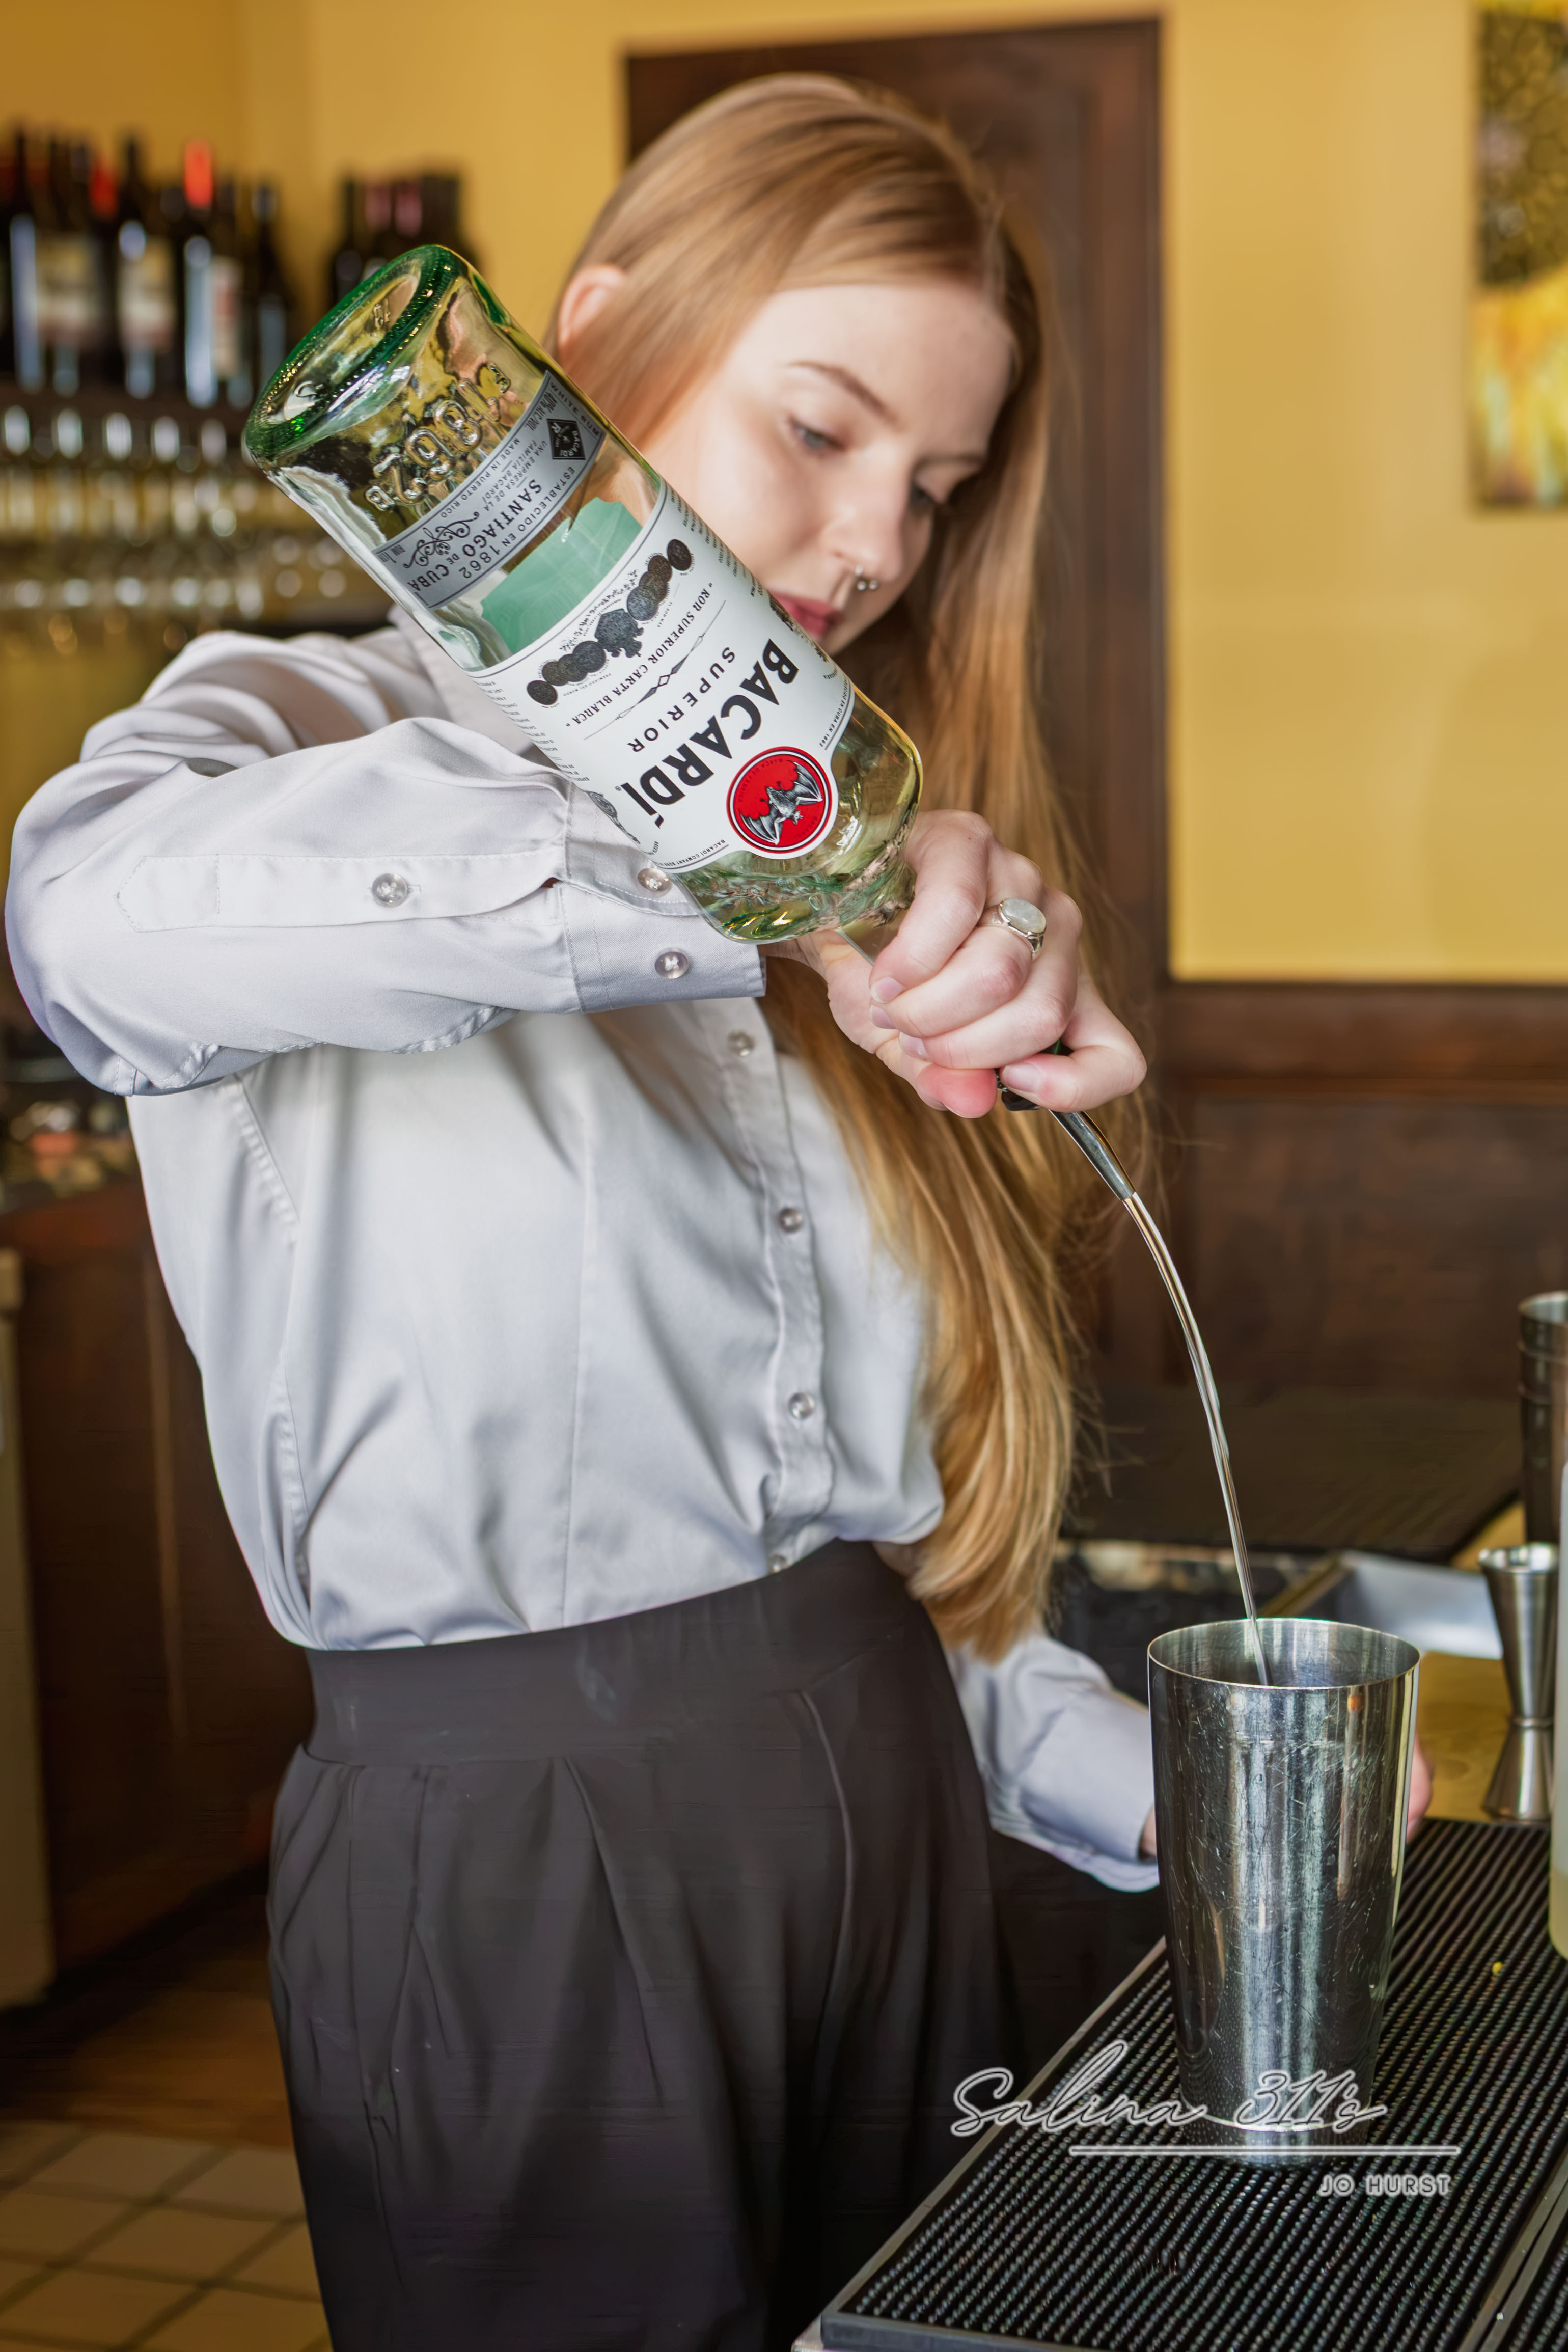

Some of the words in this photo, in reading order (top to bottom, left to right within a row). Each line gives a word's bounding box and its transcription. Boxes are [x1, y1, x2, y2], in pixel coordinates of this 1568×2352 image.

[500, 437, 519, 460] MADE
[511, 440, 536, 469] FAMILIA
[534, 440, 546, 455] UNA
[490, 460, 500, 470] IN
[505, 456, 534, 489] EMPRESA
[460, 472, 489, 501] PUERTO
[493, 489, 505, 501] DE
[517, 466, 575, 531] ESTABLECIDO
[440, 500, 460, 518] RICO
[462, 479, 541, 556] SANTIAGO
[483, 501, 493, 511] LA
[501, 532, 515, 547] EN
[446, 553, 459, 565] DE
[458, 545, 500, 579] 1862
[407, 564, 449, 589] CUBA
[647, 611, 694, 663] SUPERIOR
[611, 664, 648, 696] CARTA
[571, 695, 612, 724] BLANCA
[627, 646, 735, 752] SUPERIOR
[620, 638, 800, 828] BACARDÍ
